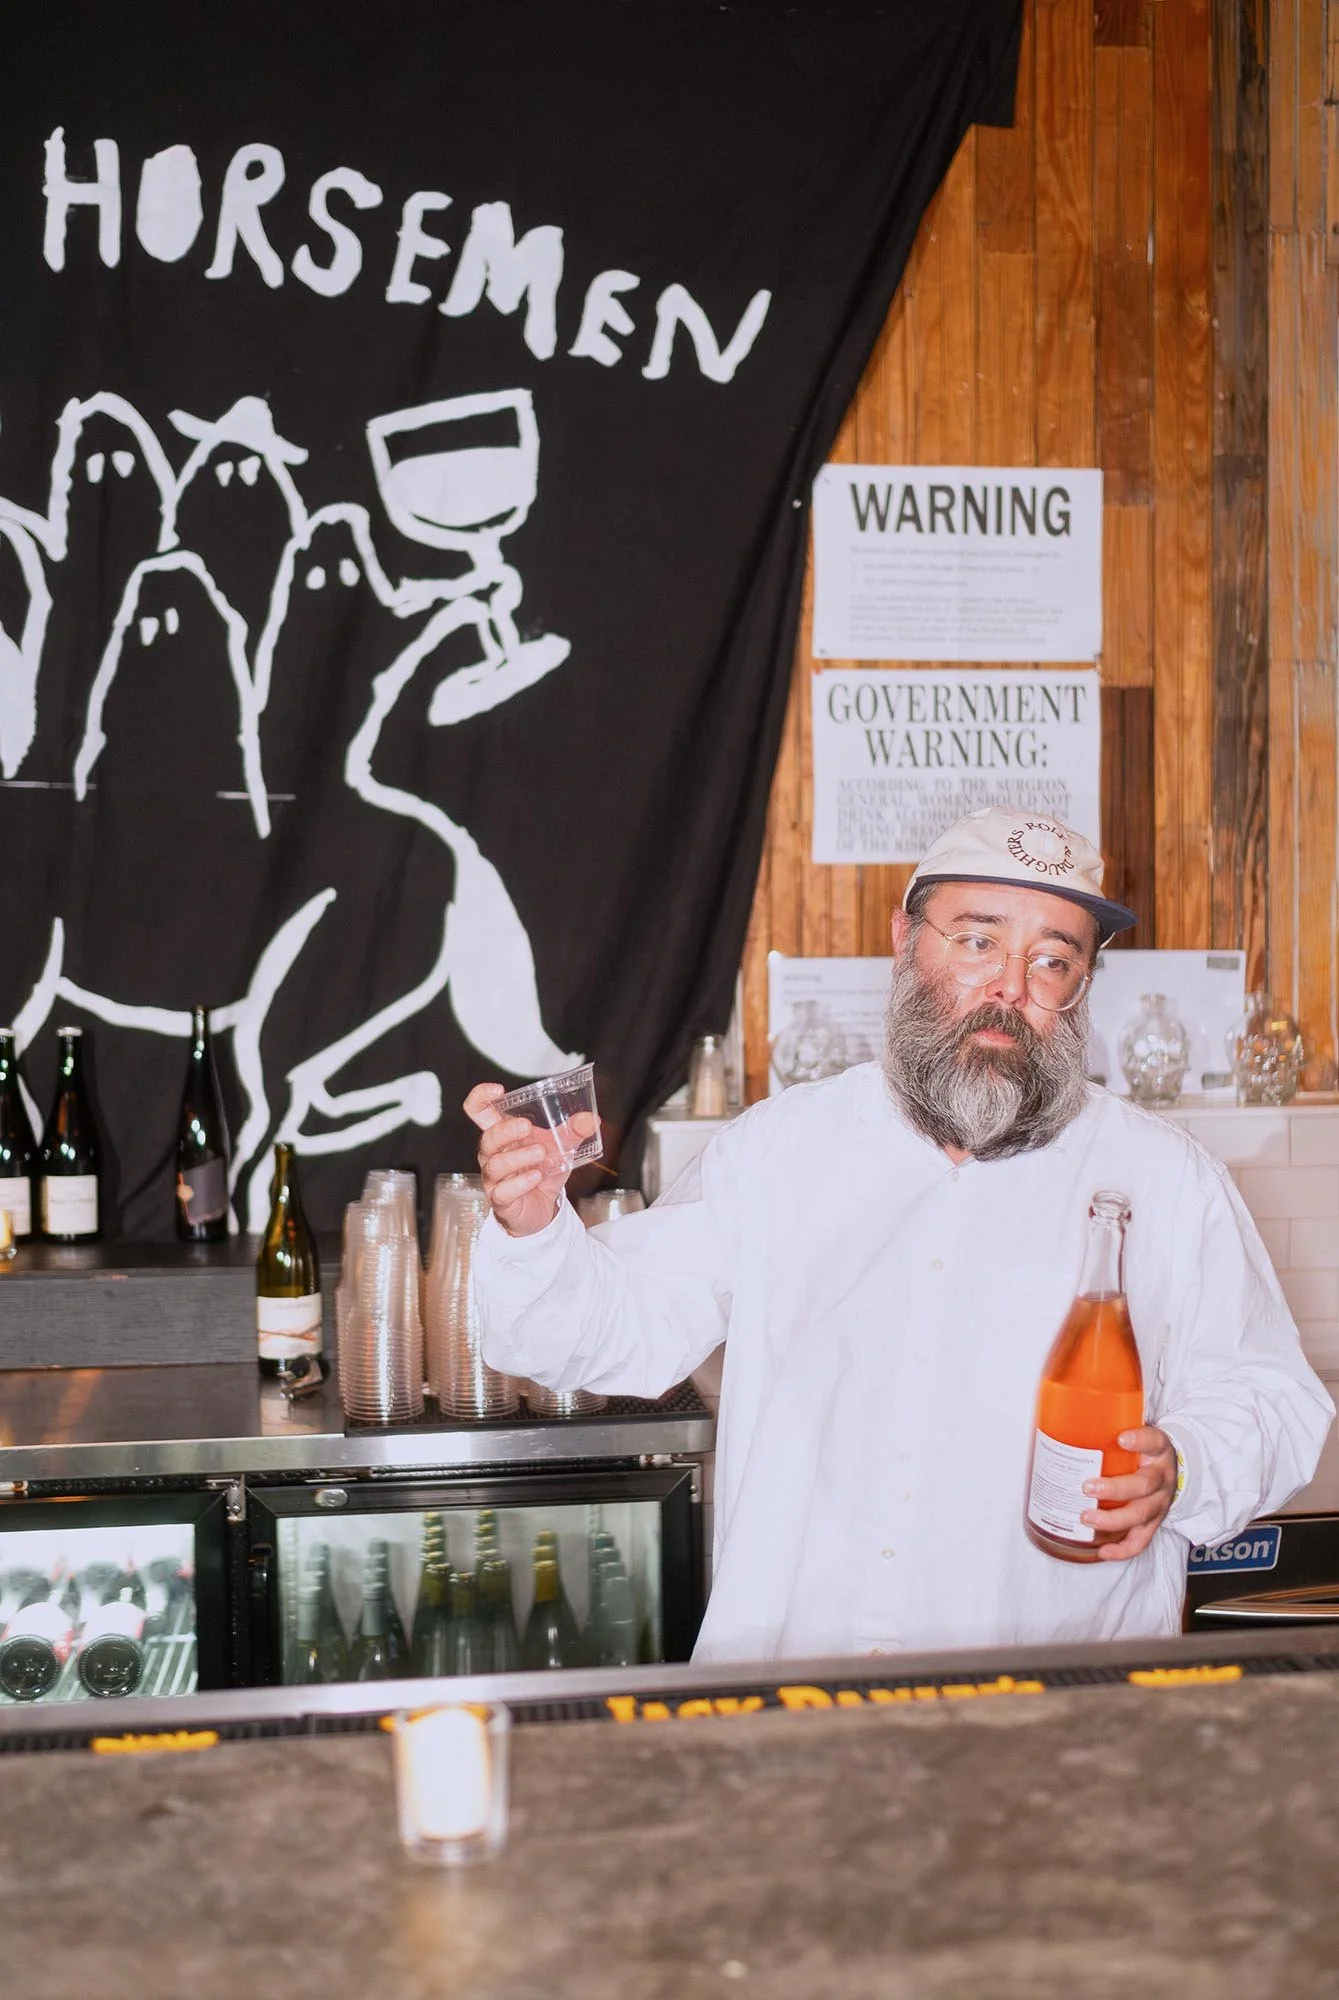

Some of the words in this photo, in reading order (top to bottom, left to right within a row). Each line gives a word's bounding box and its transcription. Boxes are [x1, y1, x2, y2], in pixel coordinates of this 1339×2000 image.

[42, 126, 772, 384] HORSEMEN
[849, 482, 1071, 537] WARNING
[827, 683, 1086, 724] GOVERNMENT
[864, 729, 1048, 769] WARNING:
[1006, 829, 1075, 876] DAUGHTERS
[1189, 1540, 1270, 1563] ckson
